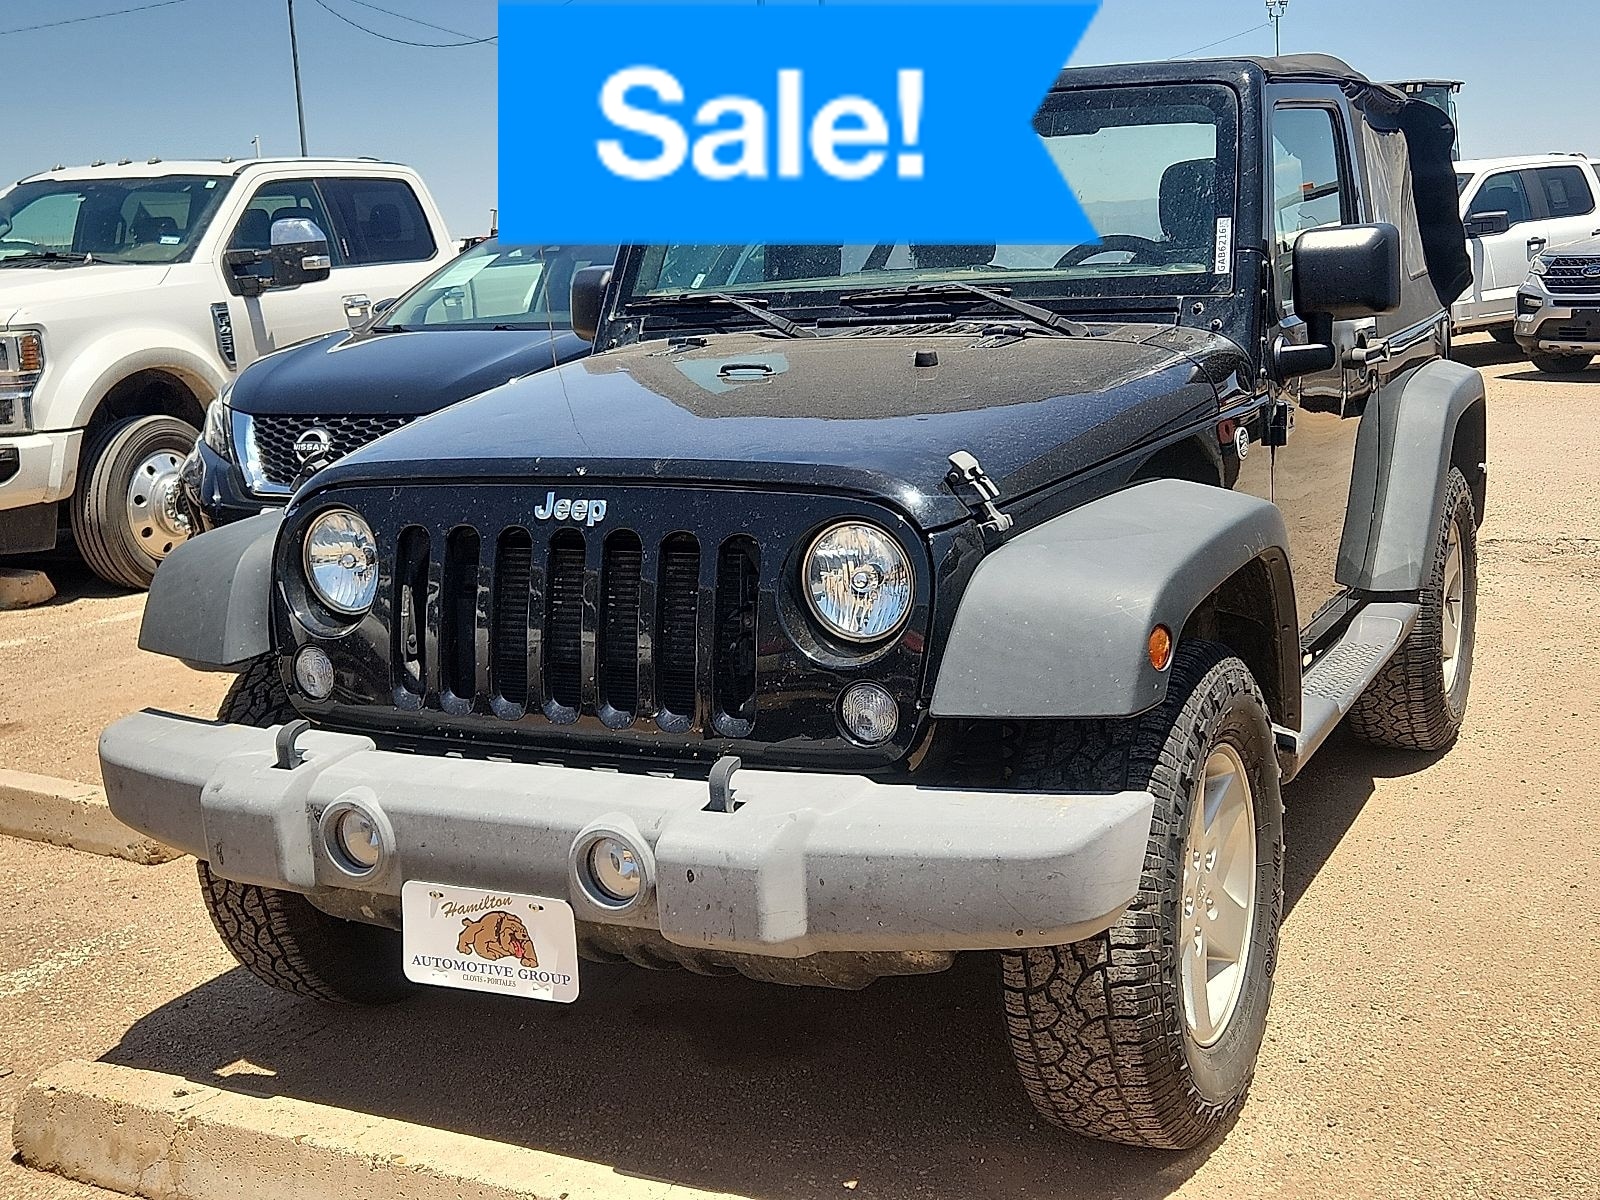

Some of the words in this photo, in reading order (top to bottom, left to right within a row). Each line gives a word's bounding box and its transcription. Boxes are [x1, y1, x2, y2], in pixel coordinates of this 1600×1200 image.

[293, 443, 330, 451] NISSAN
[534, 491, 607, 526] Jeep
[441, 895, 513, 918] Hamilton
[412, 954, 514, 978] AUTOMOTIVE
[517, 968, 571, 986] GROUP
